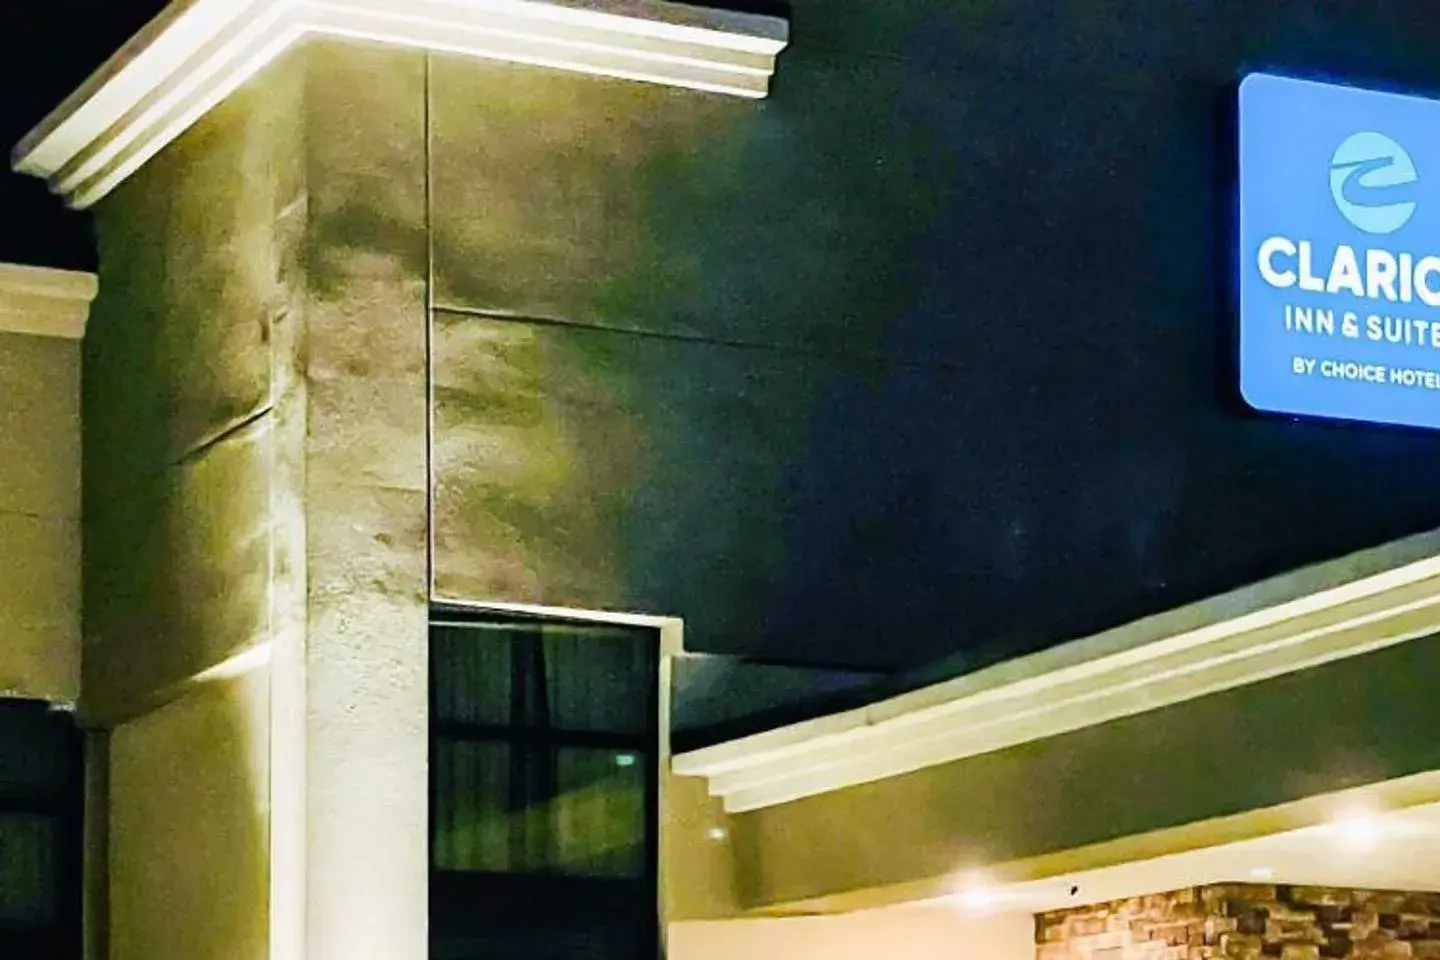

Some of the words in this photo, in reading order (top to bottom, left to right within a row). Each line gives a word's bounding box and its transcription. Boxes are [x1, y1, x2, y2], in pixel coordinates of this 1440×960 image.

[1285, 305, 1334, 336] INN
[1341, 311, 1360, 339] &
[1292, 356, 1316, 375] BY
[1320, 360, 1387, 383] CHOICE
